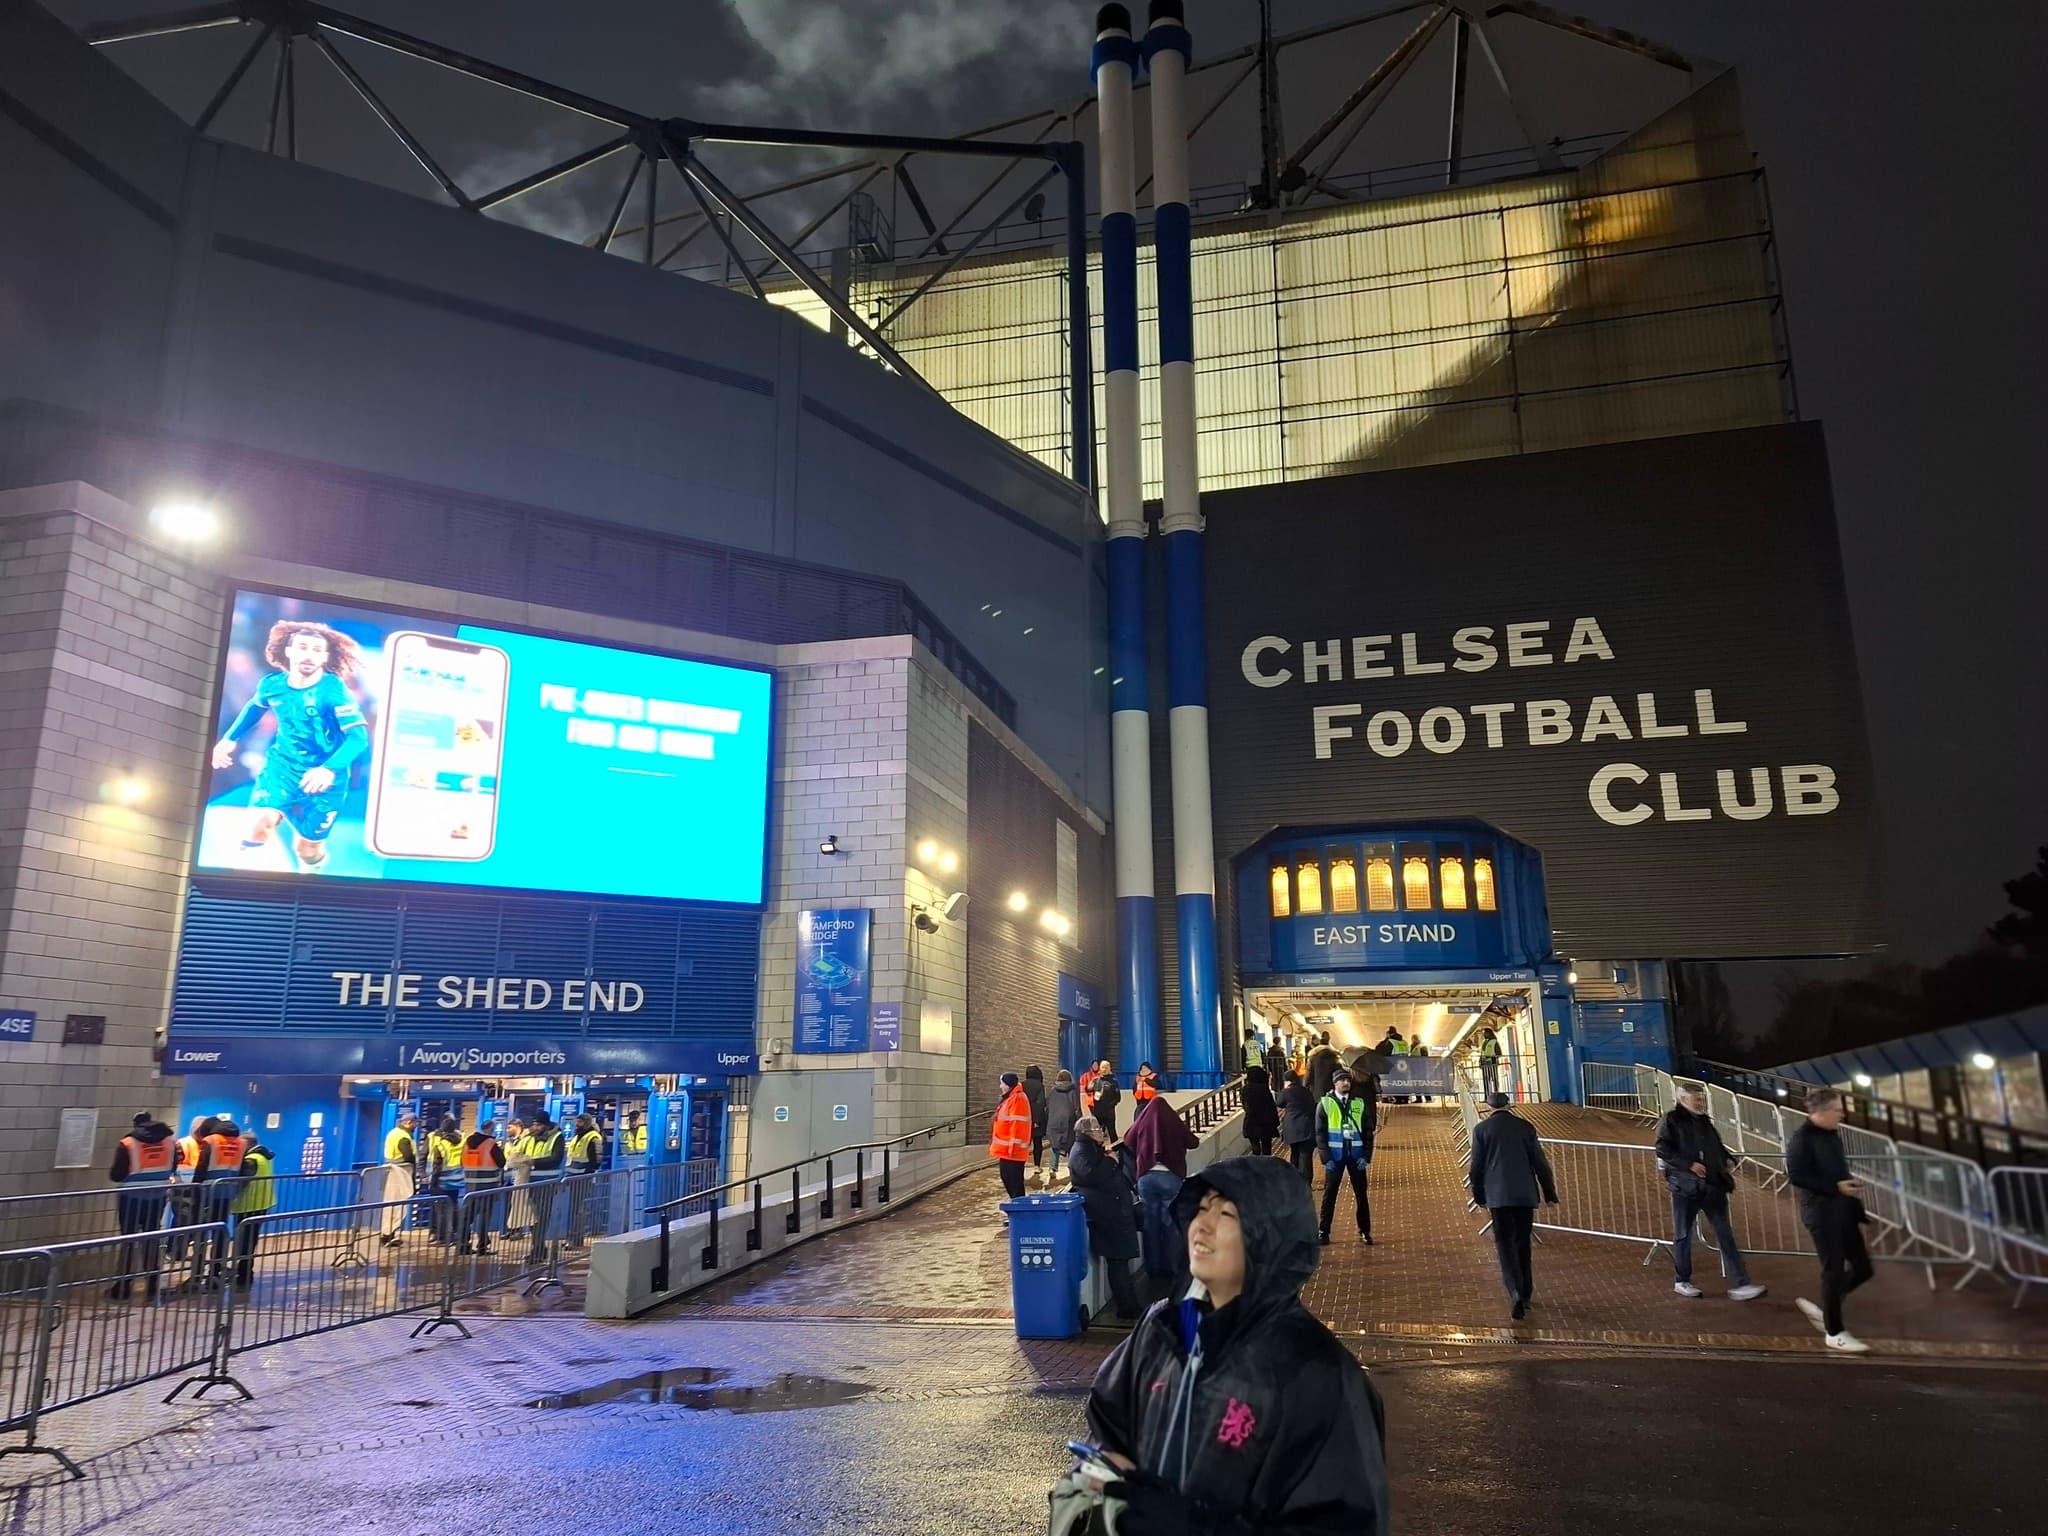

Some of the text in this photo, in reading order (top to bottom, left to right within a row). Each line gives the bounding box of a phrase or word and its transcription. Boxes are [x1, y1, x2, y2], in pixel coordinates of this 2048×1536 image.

[1241, 617, 1616, 688] CHELSEA
[1313, 688, 1748, 760] FOOTBALL
[1588, 763, 1841, 826] CLUB
[1313, 924, 1456, 946] EAST STAND
[1489, 972, 1512, 981] Upper
[332, 971, 645, 1013] THE SHED END
[174, 1049, 222, 1063] Lower
[411, 1047, 566, 1069] Away Supporters
[717, 1053, 750, 1066] Upper
